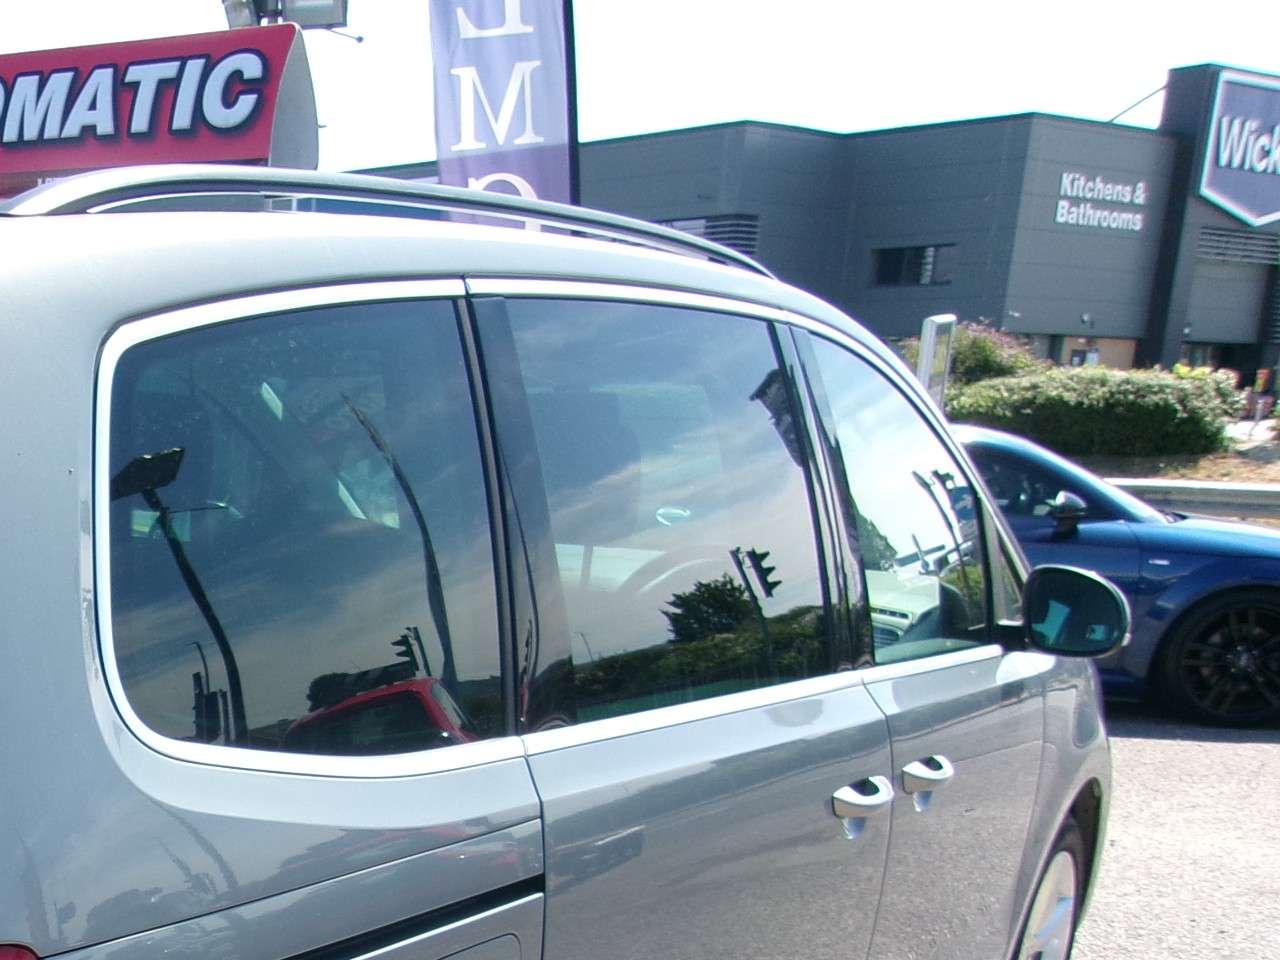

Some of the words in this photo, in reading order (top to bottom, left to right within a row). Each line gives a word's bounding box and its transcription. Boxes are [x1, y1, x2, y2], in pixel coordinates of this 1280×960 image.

[1059, 172, 1131, 204] Kitchens
[1134, 178, 1147, 205] &
[1055, 202, 1144, 231] Bathrooms
